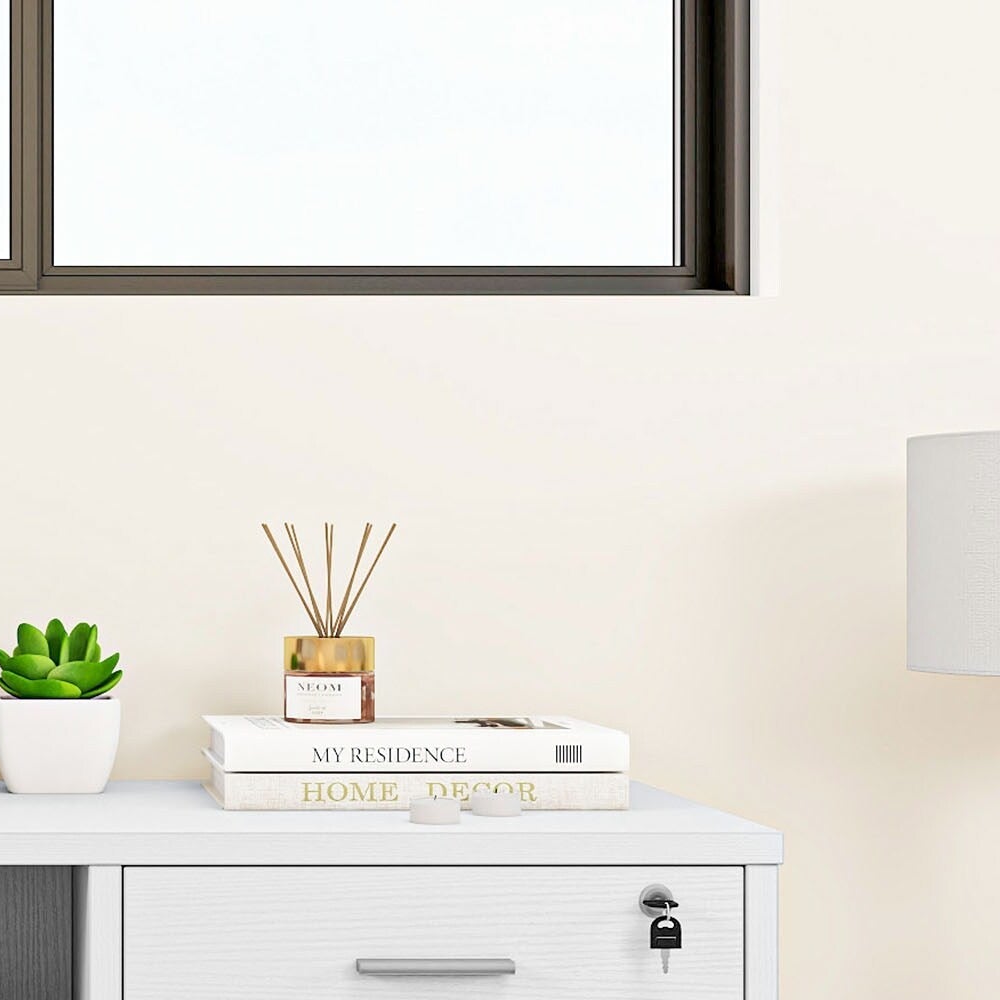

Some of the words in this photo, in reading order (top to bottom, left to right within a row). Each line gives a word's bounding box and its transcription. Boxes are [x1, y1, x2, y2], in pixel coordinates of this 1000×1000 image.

[298, 682, 342, 692] NEOM
[312, 746, 345, 763] MY
[350, 746, 468, 763] RESIDENCE
[301, 781, 399, 802] HOME
